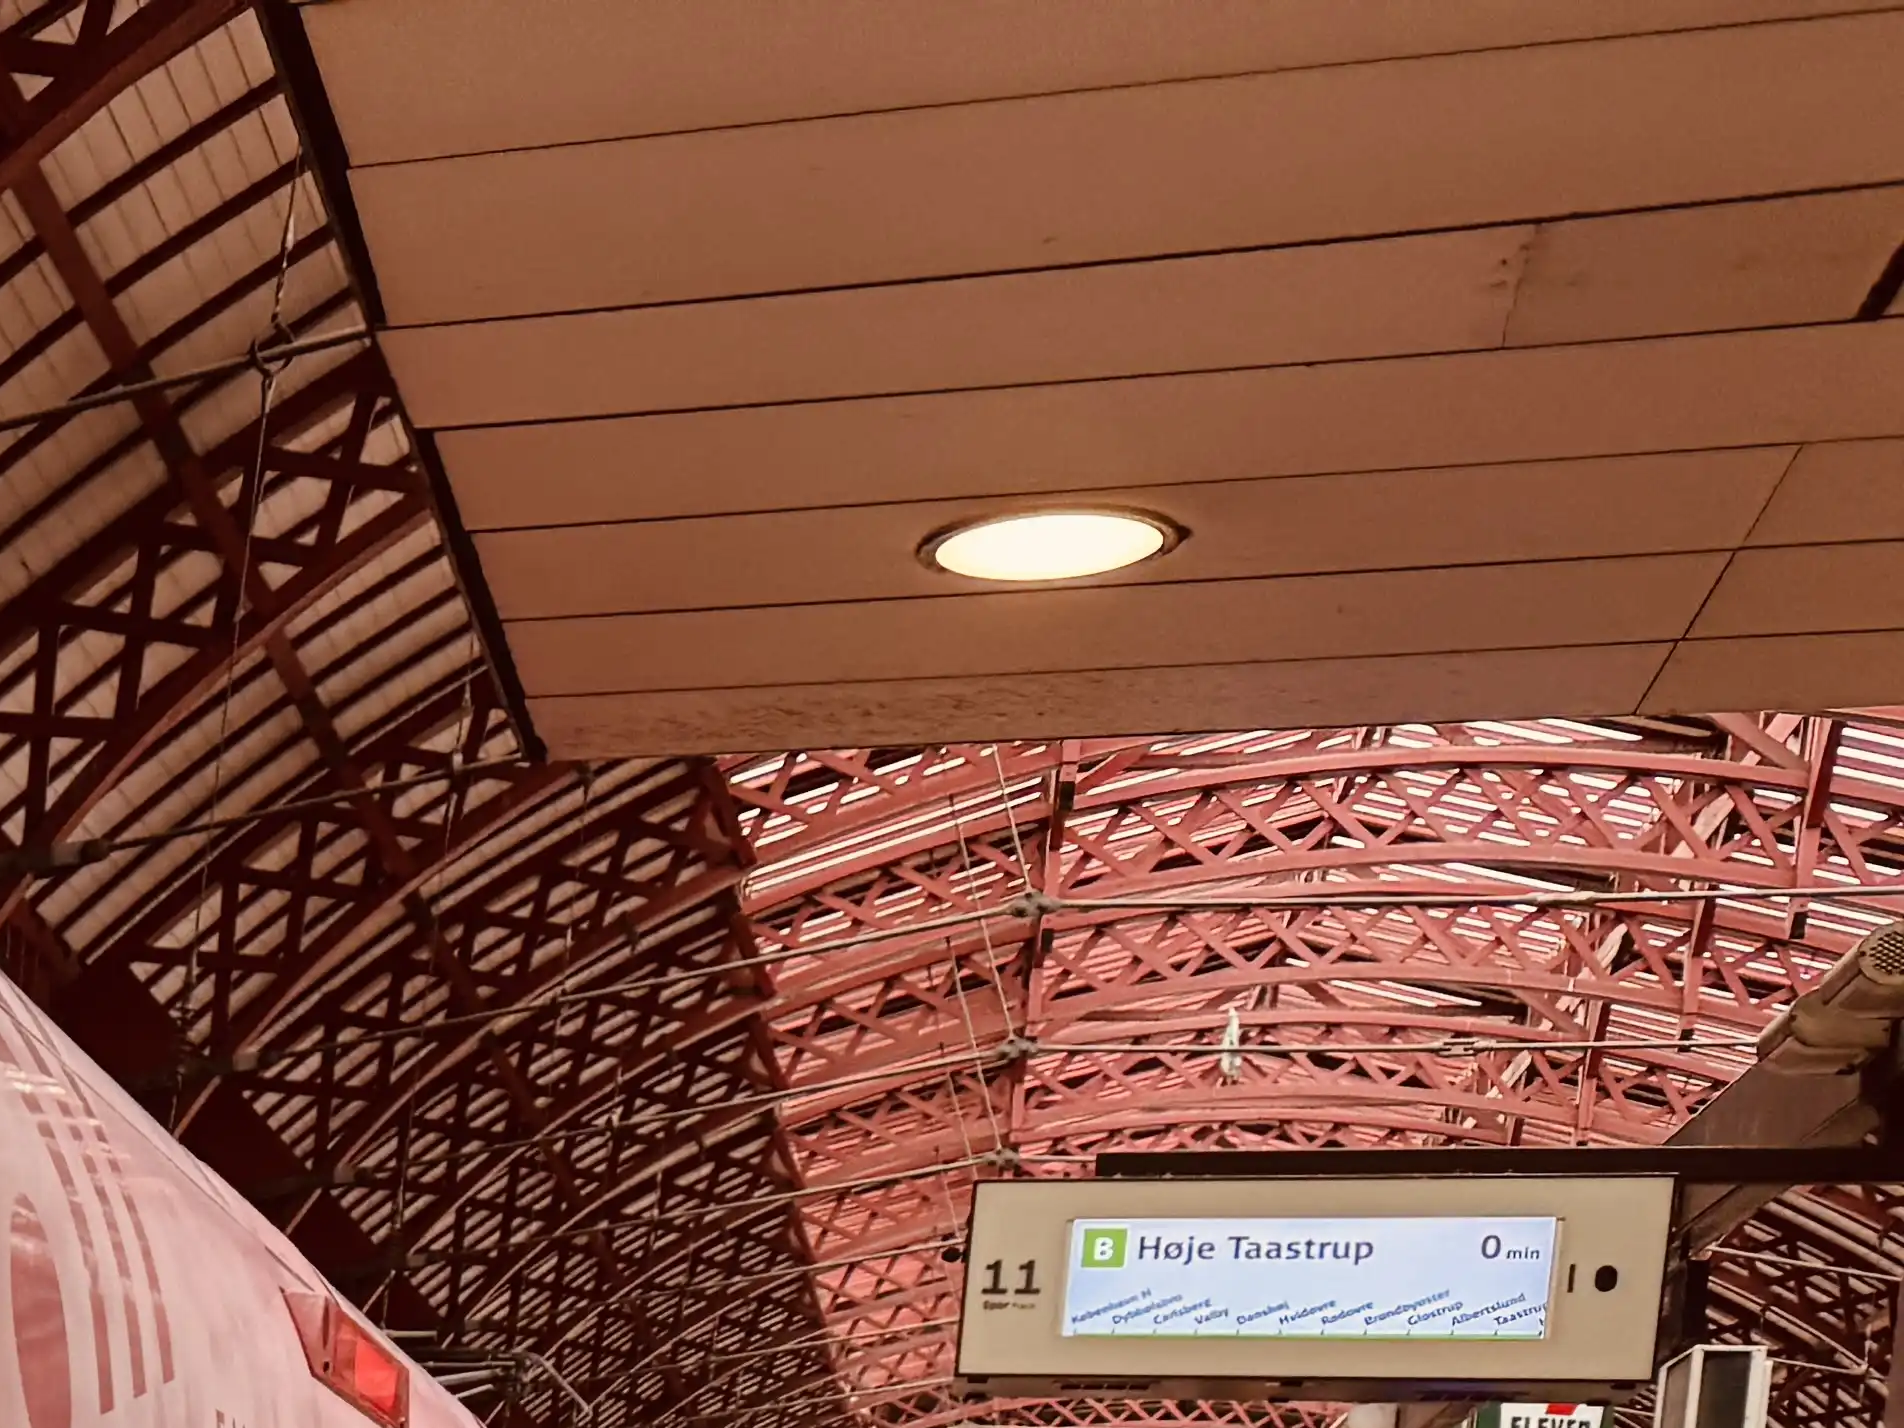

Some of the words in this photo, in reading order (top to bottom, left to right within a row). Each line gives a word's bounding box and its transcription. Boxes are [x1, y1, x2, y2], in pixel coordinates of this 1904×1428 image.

[1093, 1237, 1114, 1261] B
[1138, 1236, 1216, 1266] Høje
[1227, 1236, 1374, 1266] Taastrup
[1480, 1234, 1502, 1260] 0
[1506, 1245, 1541, 1260] min
[980, 1258, 1042, 1296] 11
[1407, 1300, 1464, 1326] Glostrup
[1451, 1292, 1526, 1326] Albertslund
